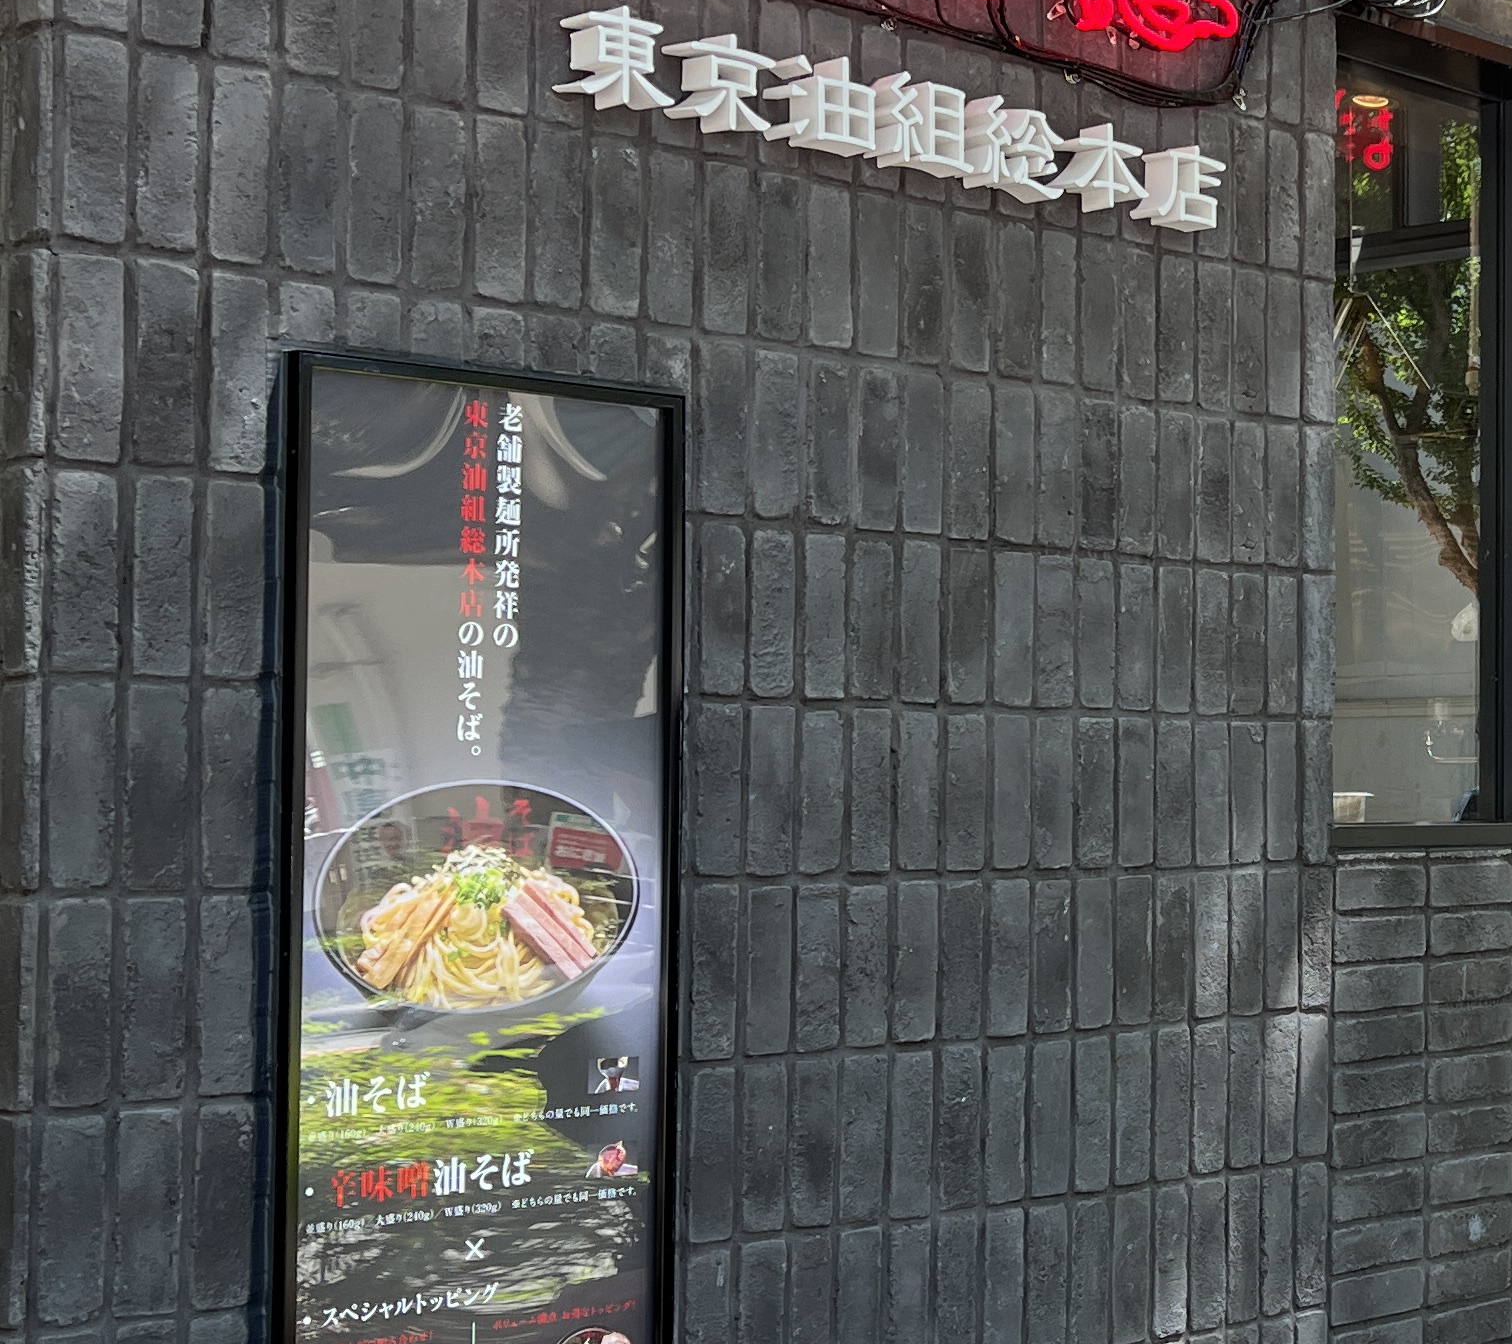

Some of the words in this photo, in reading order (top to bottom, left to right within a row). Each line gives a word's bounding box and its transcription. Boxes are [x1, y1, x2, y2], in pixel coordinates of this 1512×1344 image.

[552, 6, 1227, 233] 東京油組総本店
[456, 399, 489, 757] 東京油組総本店の油そば。
[493, 402, 525, 649] 老舗製麺所発祥の
[326, 1071, 431, 1117] 油そば
[331, 1148, 535, 1208] 辛味噌油そば
[321, 1282, 500, 1328] スペシャルトッピング
